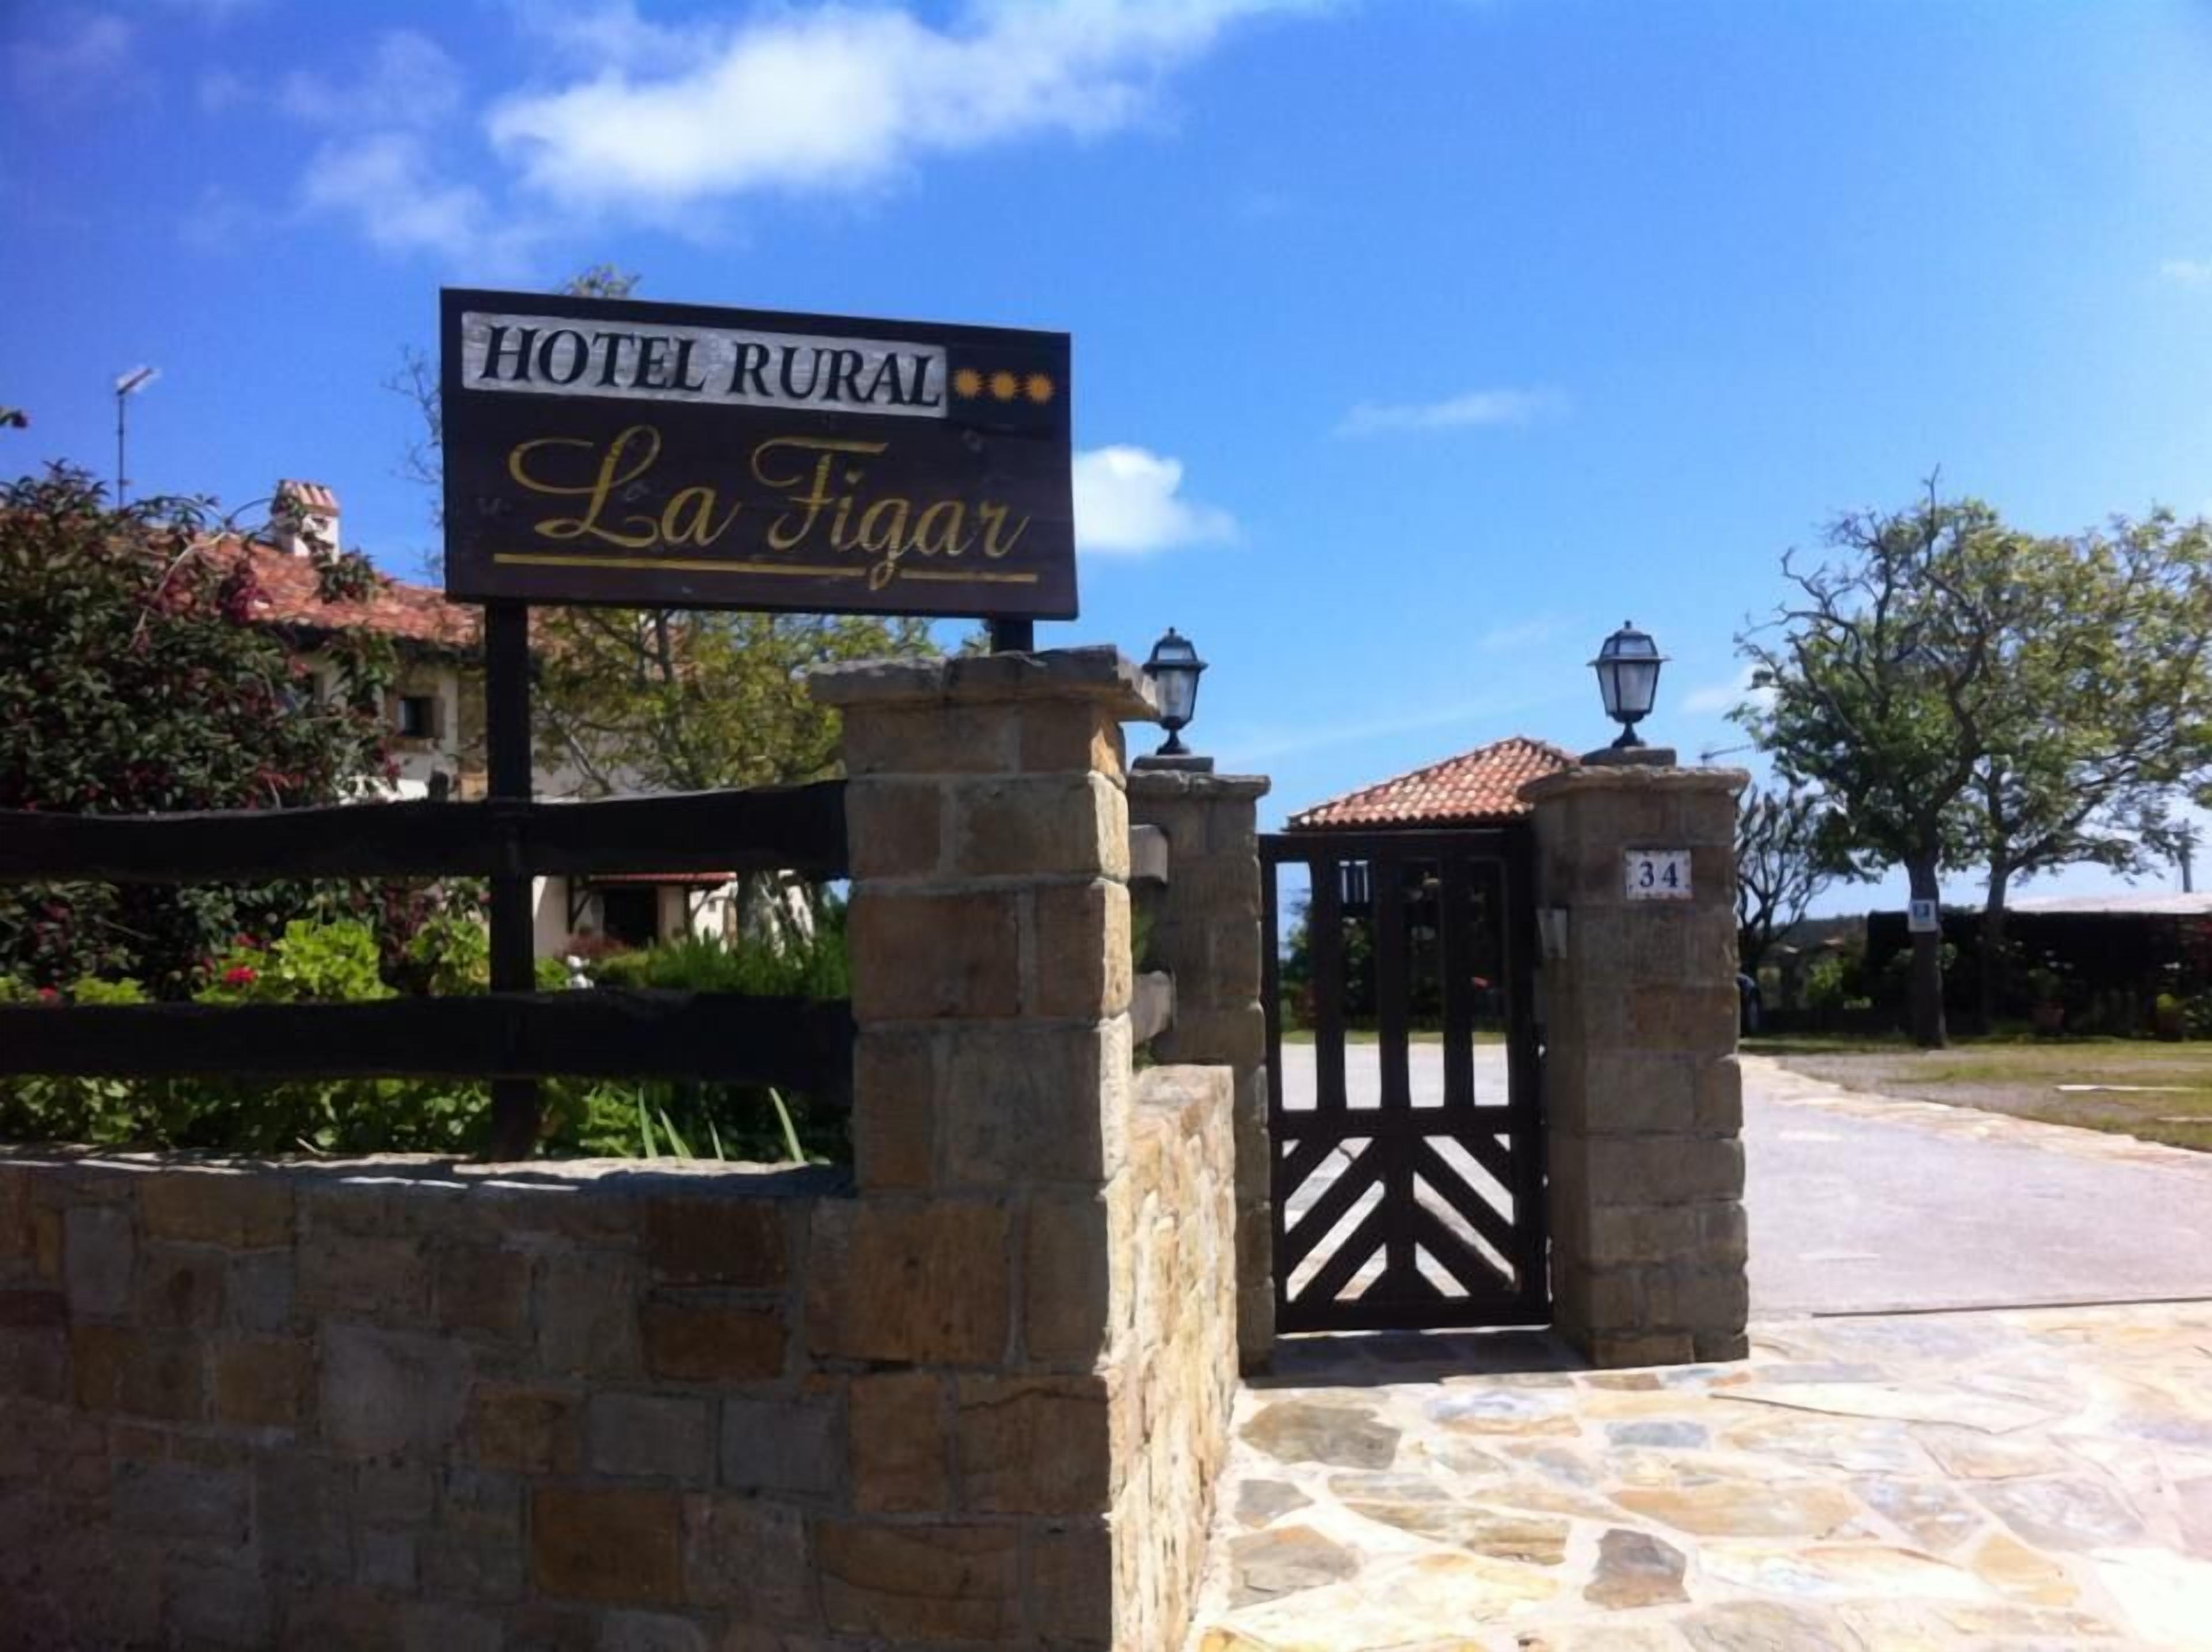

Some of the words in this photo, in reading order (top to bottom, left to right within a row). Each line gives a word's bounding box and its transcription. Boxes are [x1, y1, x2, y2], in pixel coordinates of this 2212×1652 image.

[480, 325, 707, 392] HOTEL
[728, 343, 942, 407] RURAL
[509, 425, 740, 547] La
[752, 436, 1030, 590] Figar
[1639, 861, 1677, 888] 34
